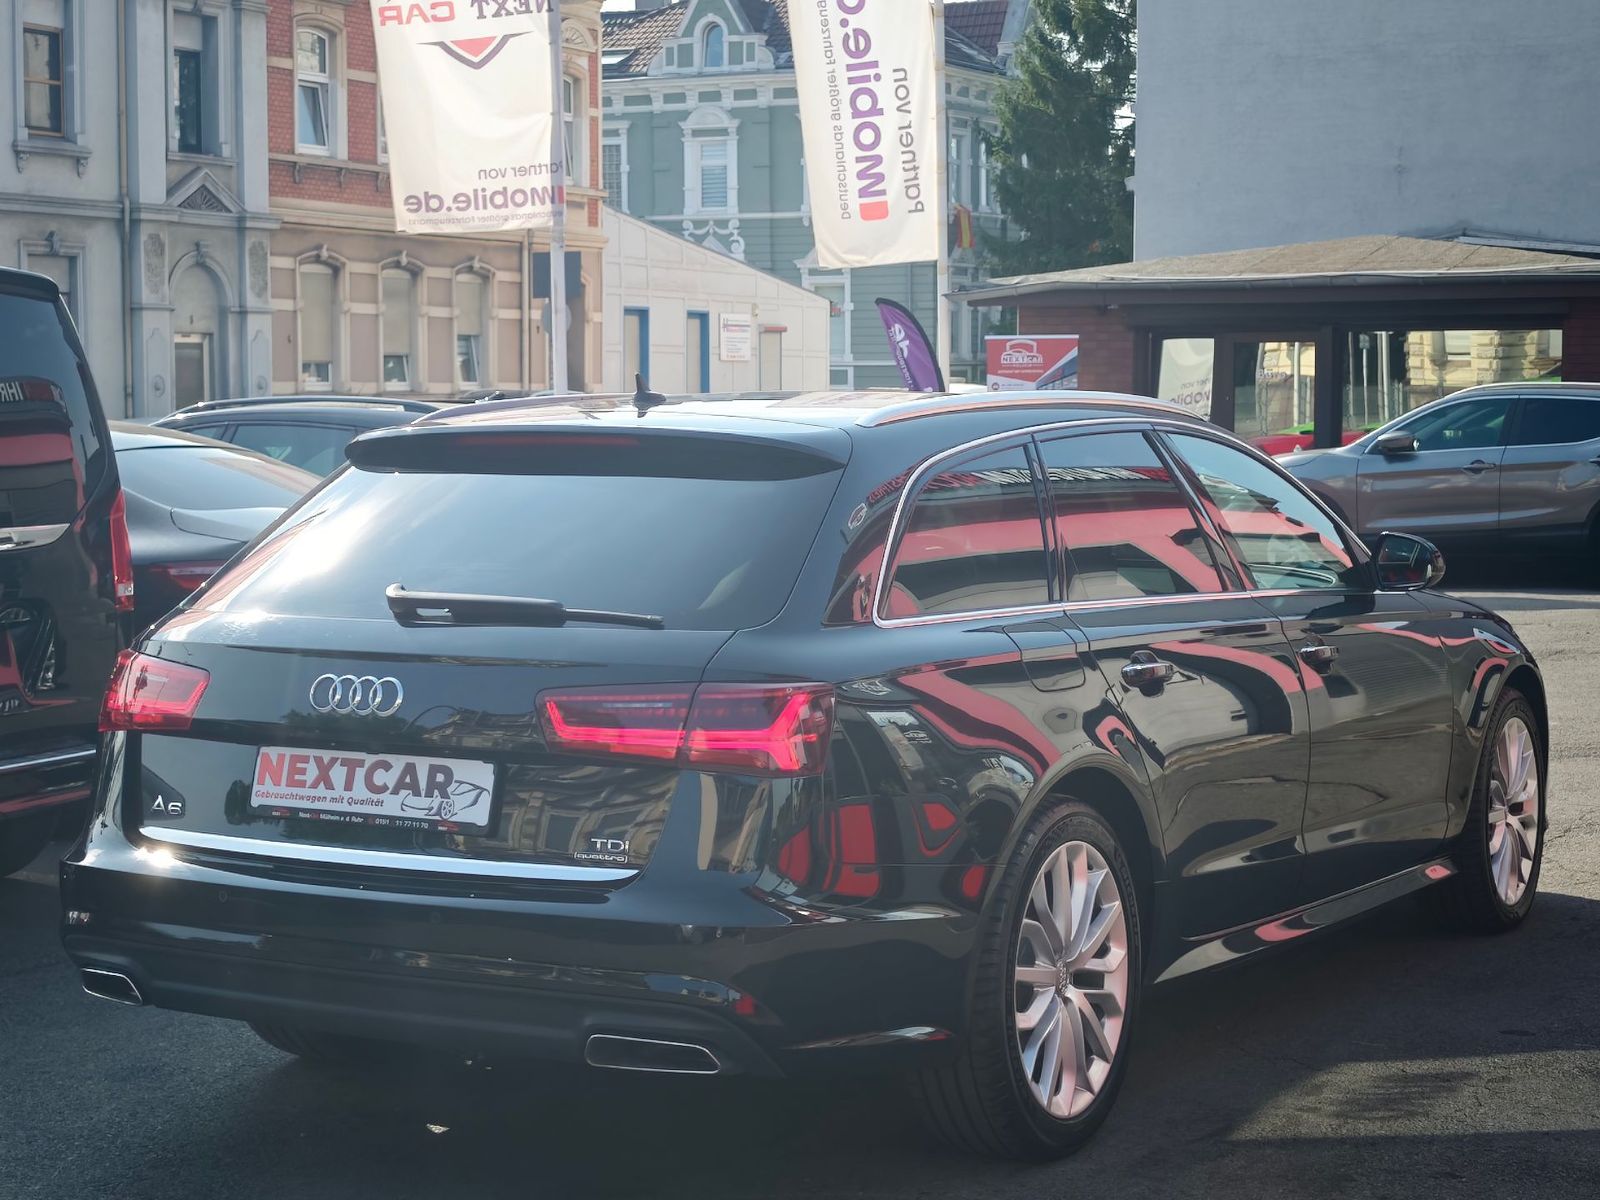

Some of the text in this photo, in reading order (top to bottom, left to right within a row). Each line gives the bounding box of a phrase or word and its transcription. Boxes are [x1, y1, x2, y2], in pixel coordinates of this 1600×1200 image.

[256, 751, 455, 799] NEXTCAR
[150, 794, 182, 816] A6
[254, 789, 385, 808] Gebrauchtwagen mit Qualität
[576, 852, 625, 862] quattro
